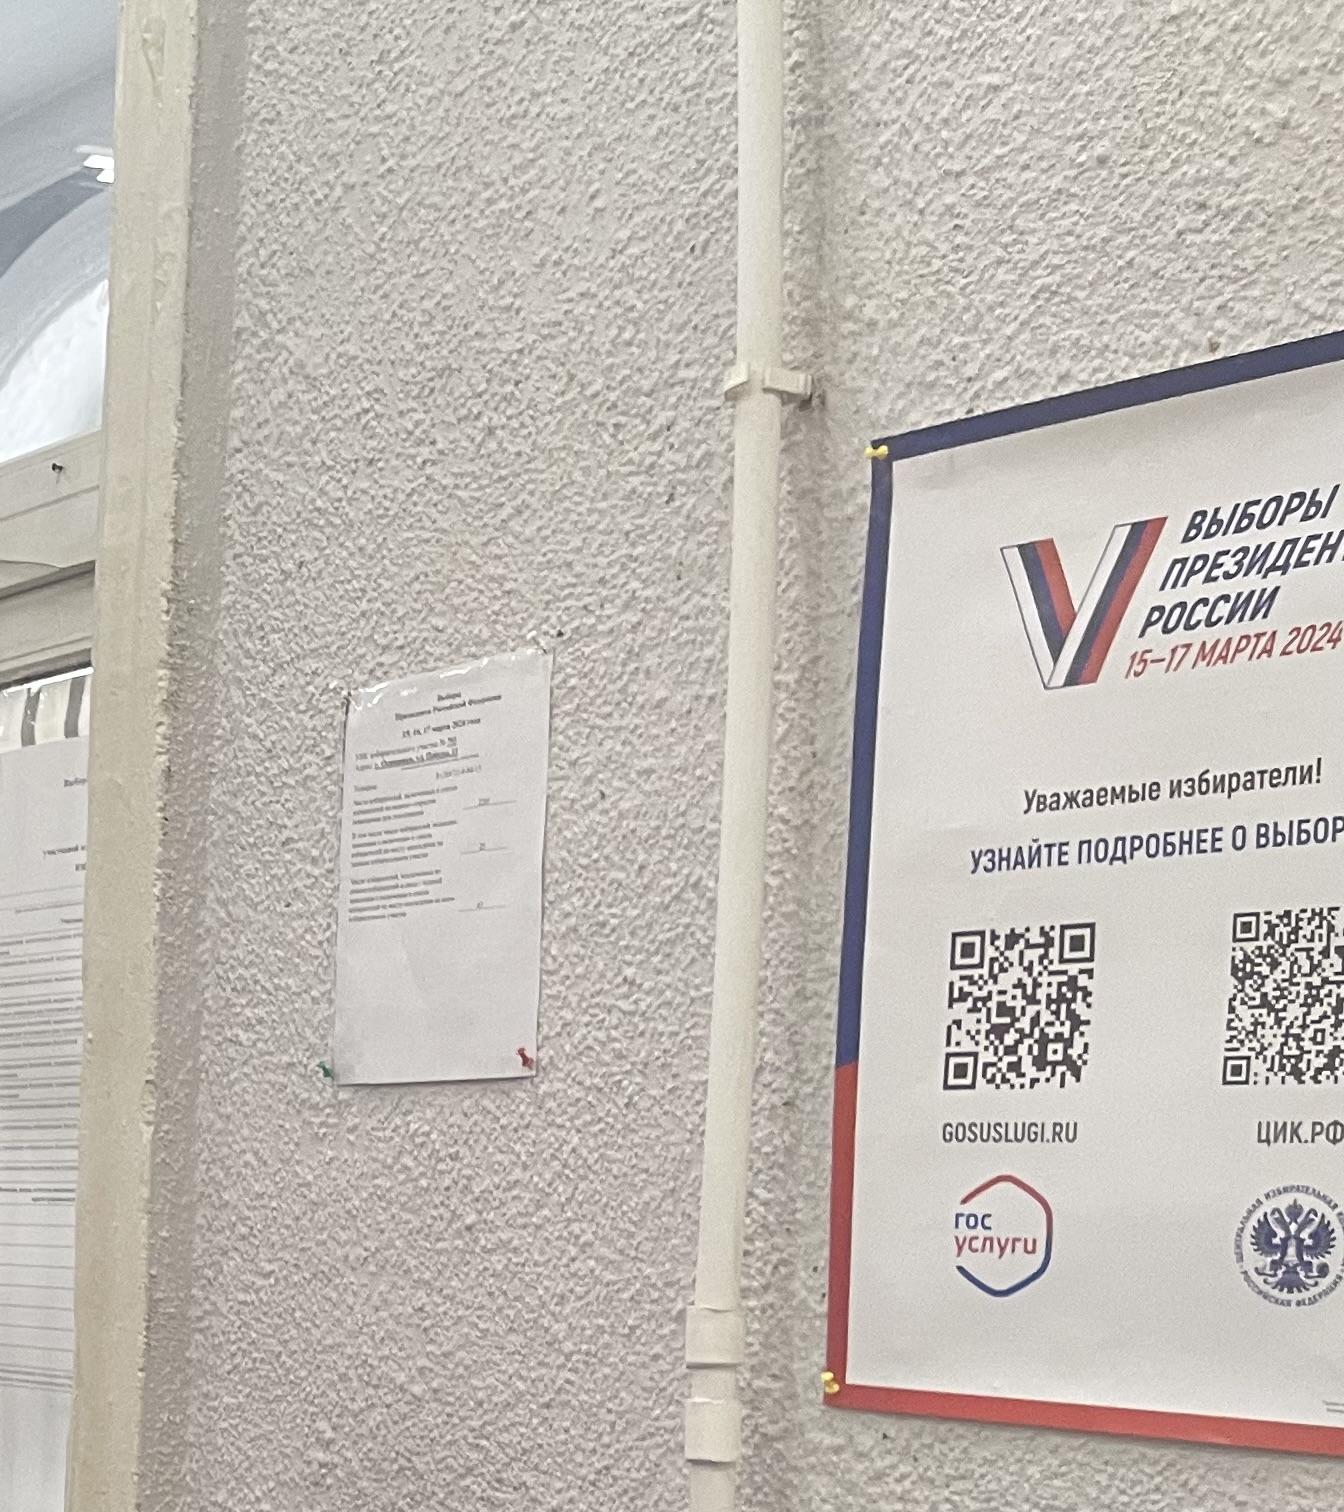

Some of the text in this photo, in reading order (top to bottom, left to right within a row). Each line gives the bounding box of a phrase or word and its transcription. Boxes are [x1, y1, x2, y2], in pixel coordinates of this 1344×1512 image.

[1181, 484, 1340, 544] ВЫБОРЫ
[1159, 529, 1344, 591] ПРЕЗИДЕН
[1138, 585, 1281, 638] РОССИИ
[1191, 630, 1278, 669] МАРТА
[1279, 620, 1343, 657] 2024
[1023, 757, 1322, 814] Уважаемые избиратели!
[970, 838, 1069, 875] УЗНАЙТЕ
[1077, 826, 1222, 866] ПОДРОБНЕЕ
[1231, 825, 1246, 851] О
[942, 1121, 1078, 1144] GOSUSLUGI.RU
[1257, 1119, 1344, 1147] ЦИК.РФ
[955, 1212, 992, 1230] гос
[955, 1233, 1037, 1257] услуги
